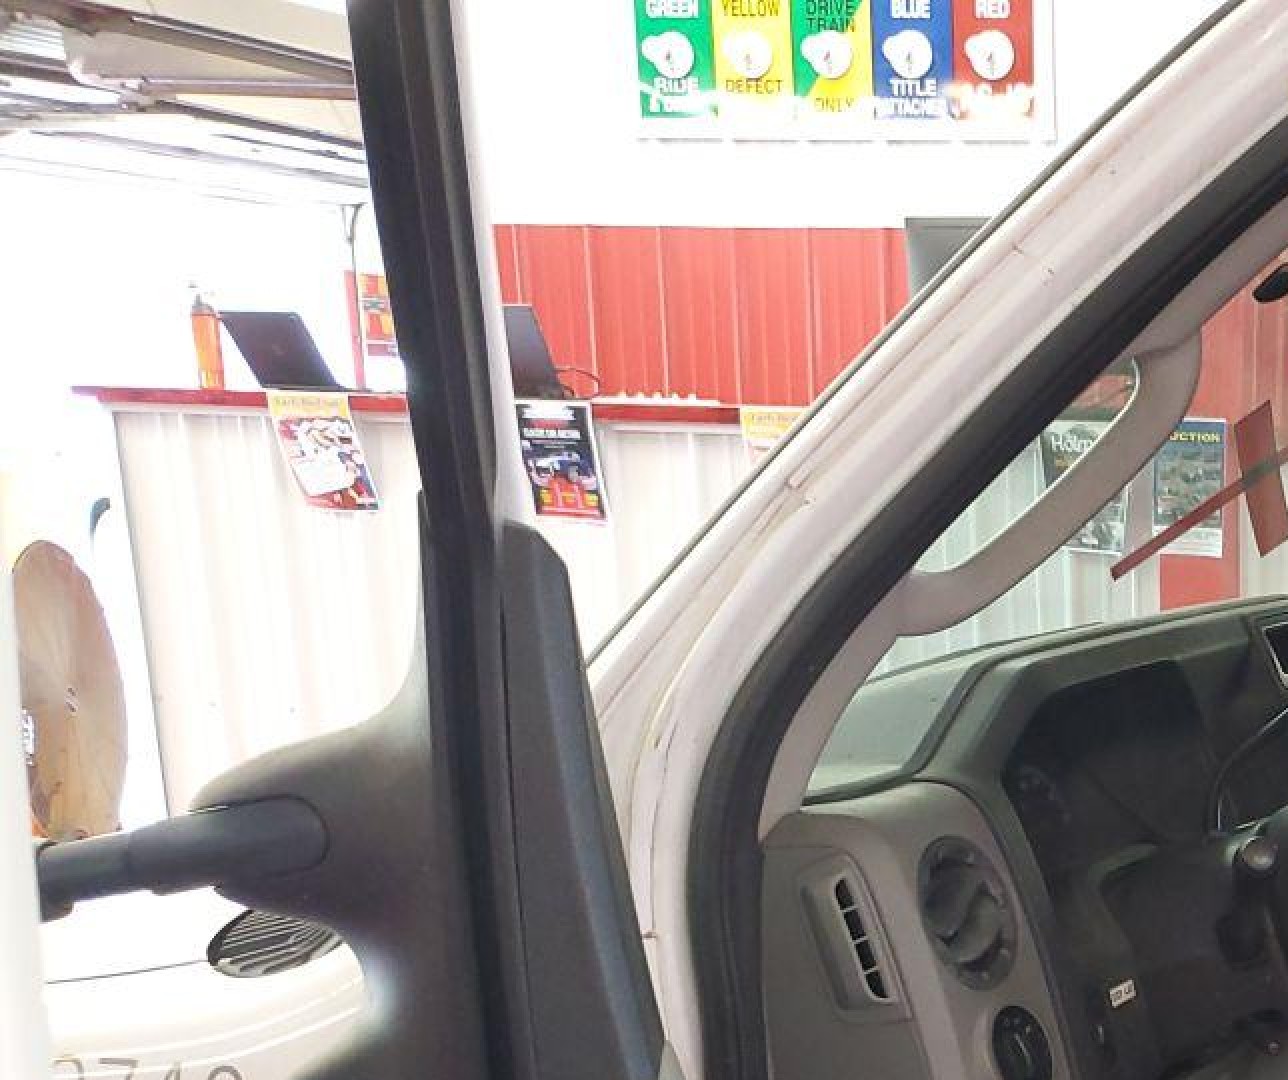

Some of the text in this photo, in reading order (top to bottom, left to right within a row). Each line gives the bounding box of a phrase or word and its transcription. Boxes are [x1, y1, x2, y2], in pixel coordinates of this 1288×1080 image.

[645, 0, 699, 19] GREEN
[721, 0, 780, 17] YELLOW
[806, 0, 856, 16] DRIVE
[889, 0, 931, 19] BLUE
[974, 0, 1011, 19] RED
[806, 17, 856, 33] TRAIN
[725, 79, 783, 94] DEFECT
[889, 79, 937, 97] TITLE
